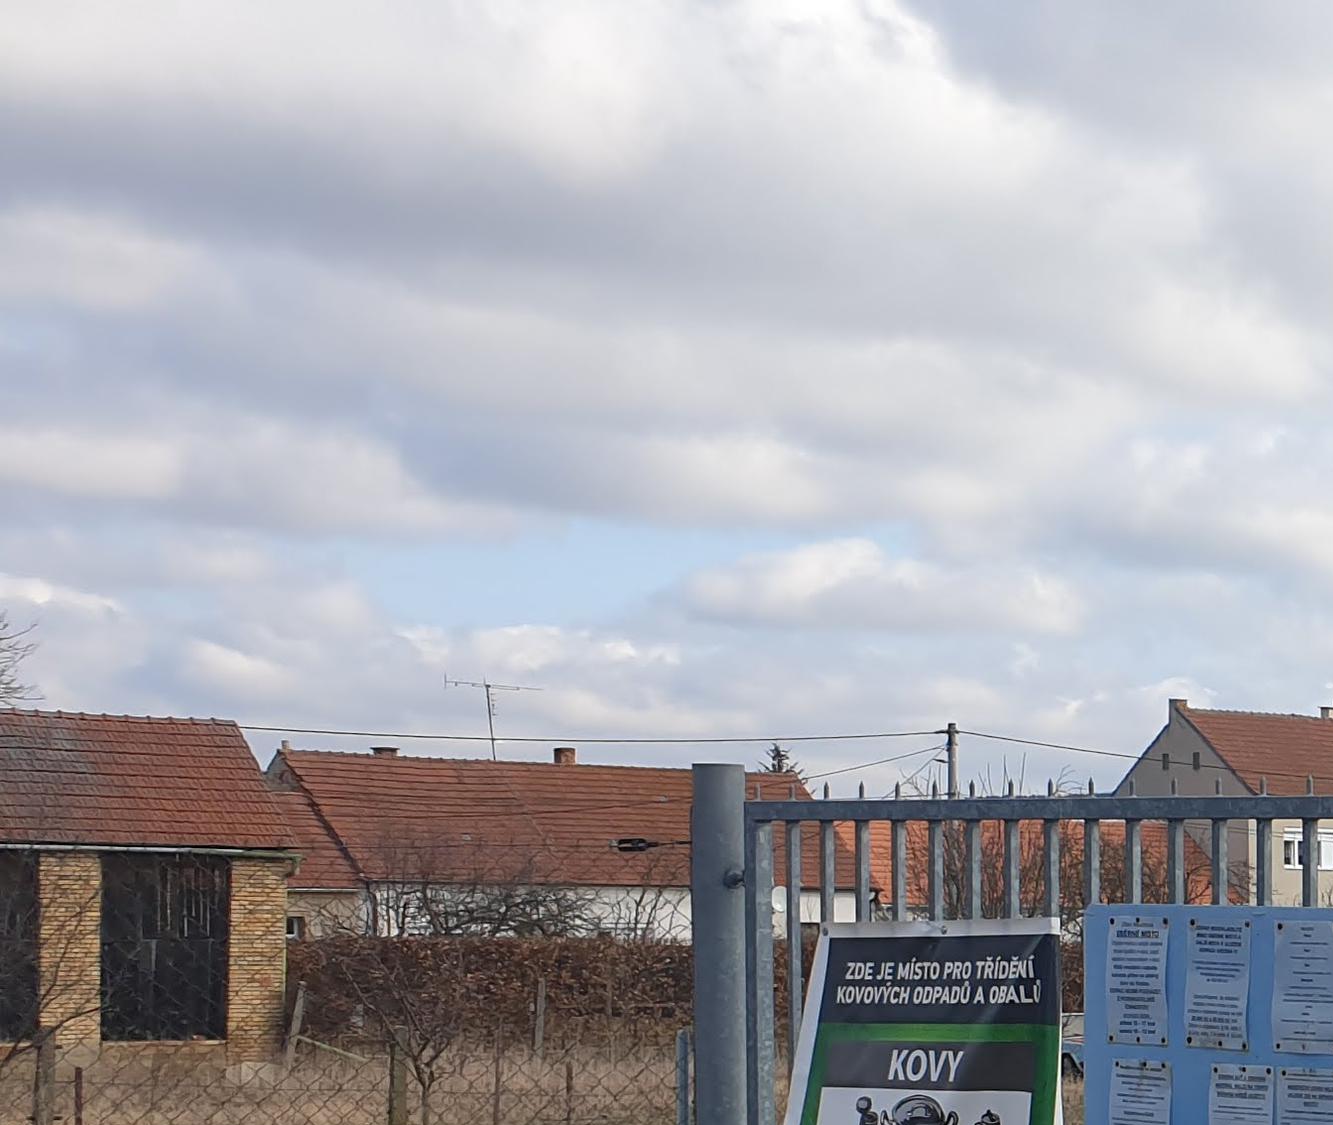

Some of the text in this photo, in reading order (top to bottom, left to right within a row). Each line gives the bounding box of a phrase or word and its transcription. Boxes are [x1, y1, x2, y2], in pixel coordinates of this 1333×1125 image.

[845, 955, 1035, 980] ZDE JE MÍSTO PRO TŘÍDĚNÍ
[836, 979, 1042, 1004] KOVOVÝCH ODPADŮ A OBALŮ
[888, 1049, 964, 1082] KOVY
